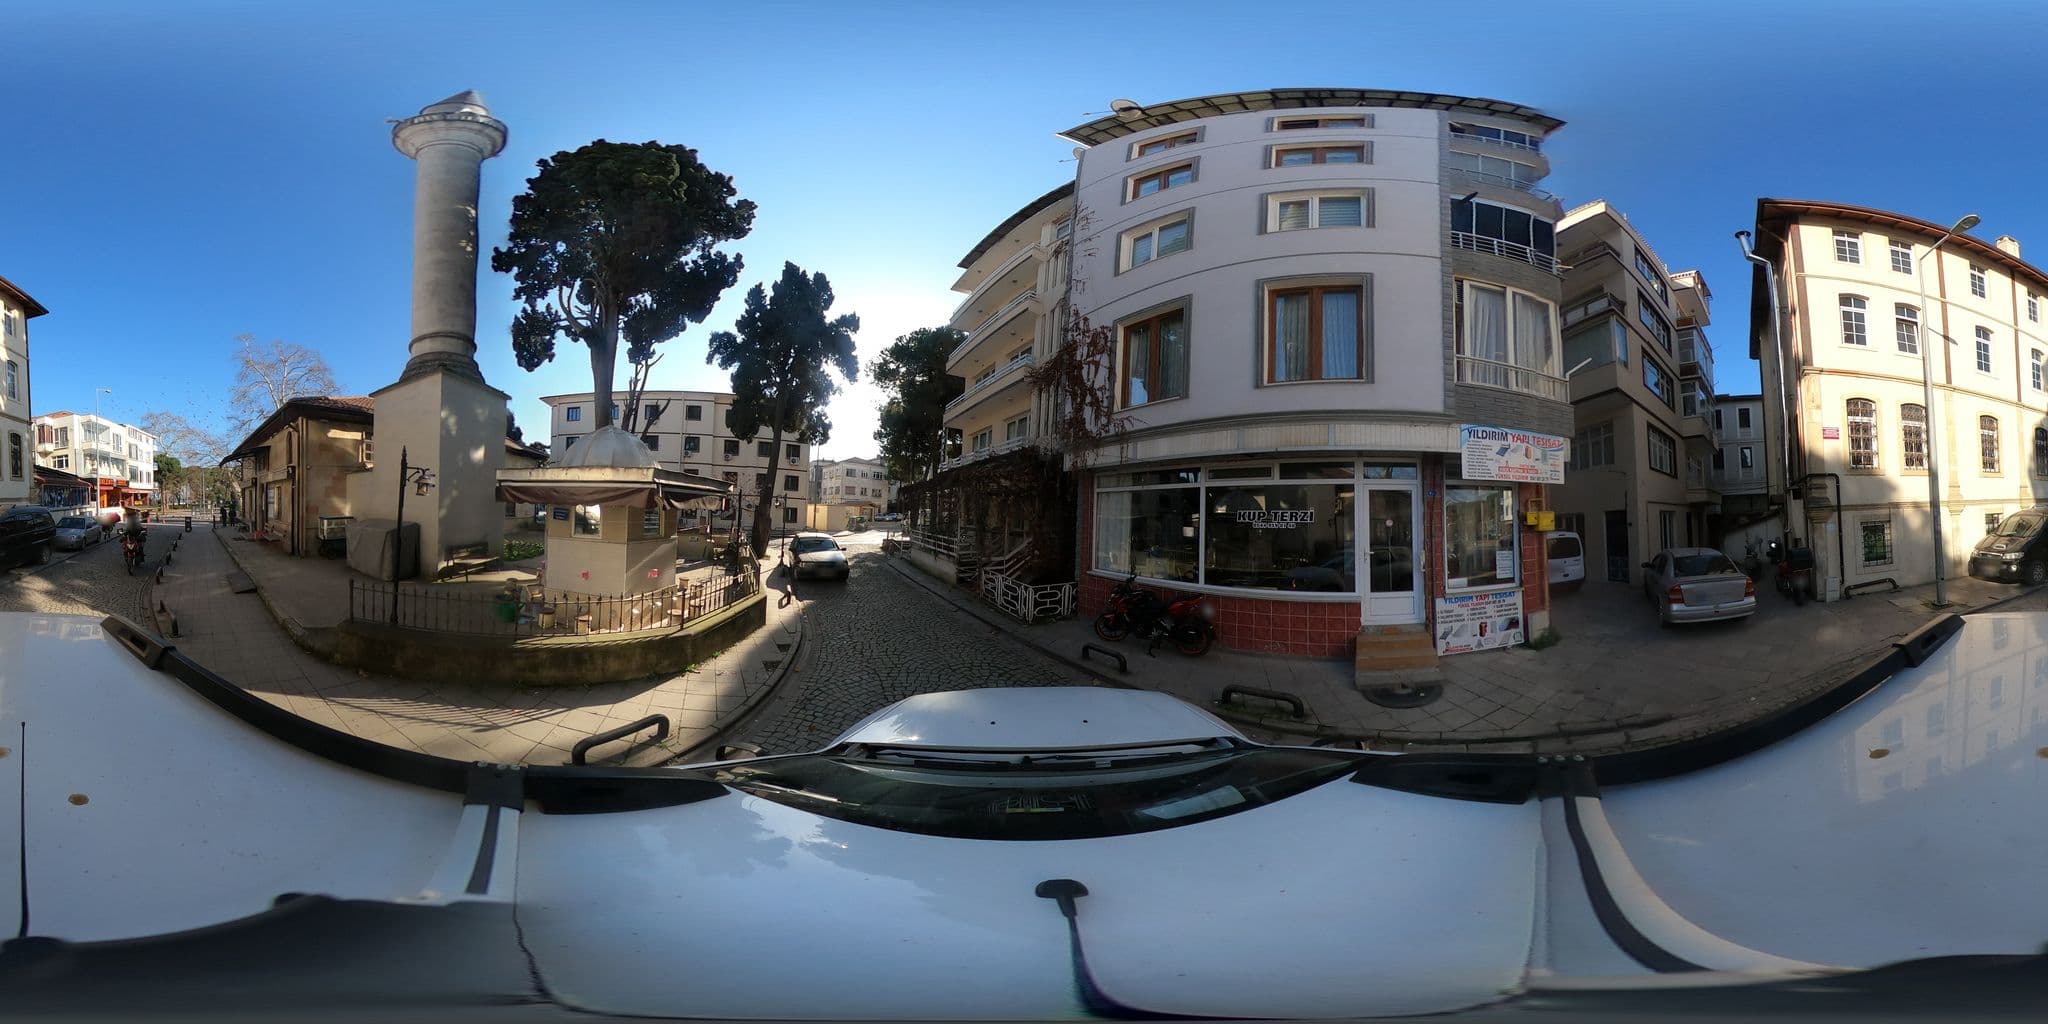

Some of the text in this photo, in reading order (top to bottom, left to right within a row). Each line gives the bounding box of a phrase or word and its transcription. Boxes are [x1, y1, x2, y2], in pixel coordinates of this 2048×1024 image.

[1467, 428, 1508, 442] YILDIRIM
[1510, 433, 1530, 444] YAPI
[1444, 595, 1473, 604] YILDIRIM
[1475, 593, 1489, 602] YAPI
